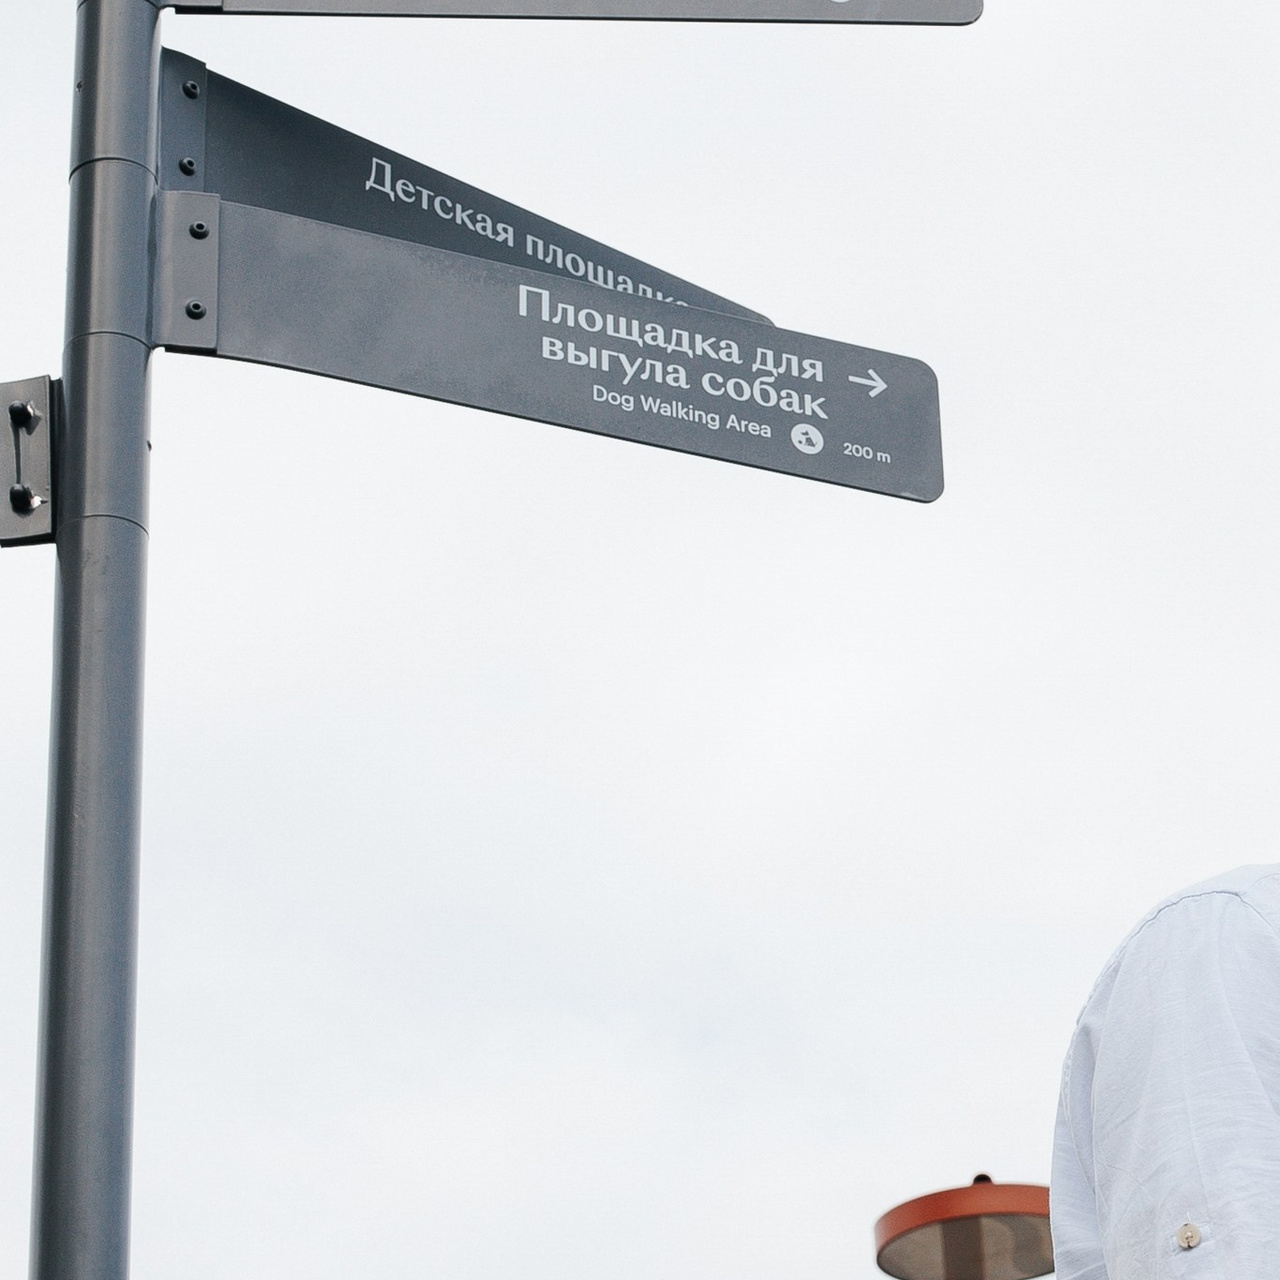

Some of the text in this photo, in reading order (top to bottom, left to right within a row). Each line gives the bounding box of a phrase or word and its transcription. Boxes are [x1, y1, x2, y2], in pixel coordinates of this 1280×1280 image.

[366, 157, 515, 248] Детская
[518, 283, 824, 382] Площадка для
[541, 335, 829, 420] выгула собак
[592, 384, 892, 464] Dog Walking Area 200 m
